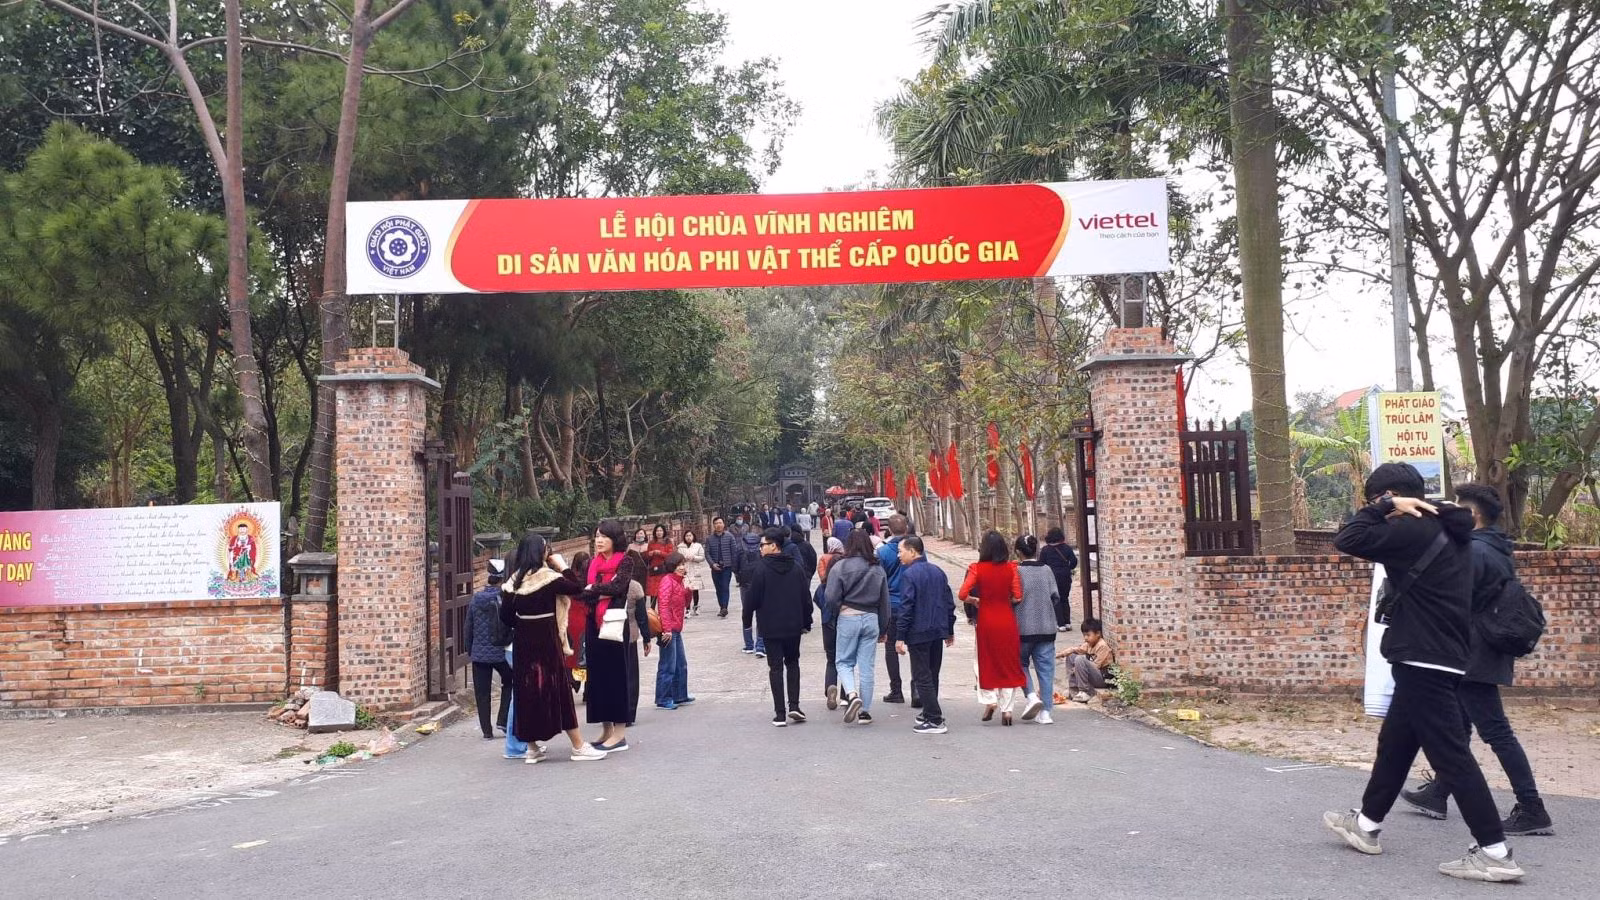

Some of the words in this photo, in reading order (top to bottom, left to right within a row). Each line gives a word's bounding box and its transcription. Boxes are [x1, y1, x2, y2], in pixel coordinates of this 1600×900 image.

[600, 210, 627, 239] LỄ
[635, 213, 675, 242] HỘI
[683, 211, 748, 237] CHÙA
[754, 210, 811, 235] VĨNH
[819, 206, 914, 233] NGHIÊM
[1078, 212, 1159, 230] viettel
[370, 229, 382, 248] GIÁO
[380, 220, 394, 231] HỘI
[395, 219, 416, 230] PHẬT
[414, 228, 427, 247] GIÁO
[1146, 231, 1159, 239] bạn
[497, 254, 521, 276] DI
[529, 246, 580, 275] SẢN
[586, 248, 636, 274] VĂN
[644, 247, 692, 272] HÓA
[700, 250, 739, 272] PHI
[747, 245, 790, 275] VẬT
[798, 239, 842, 269] THỂ
[849, 238, 897, 267] CẤP
[905, 236, 970, 266] QUỐC
[978, 240, 1019, 262] GIA
[383, 265, 399, 276] VIỆT
[400, 264, 416, 275] NAM
[1385, 396, 1410, 411] PHẬT
[1412, 395, 1435, 409] GIÁO
[1385, 411, 1410, 424] TRÚC
[1413, 411, 1434, 423] LÂM
[1397, 429, 1413, 443] HỘI
[1415, 431, 1428, 443] TỤ
[1409, 444, 1436, 456] SÁNG
[7, 562, 34, 586] DẠY
